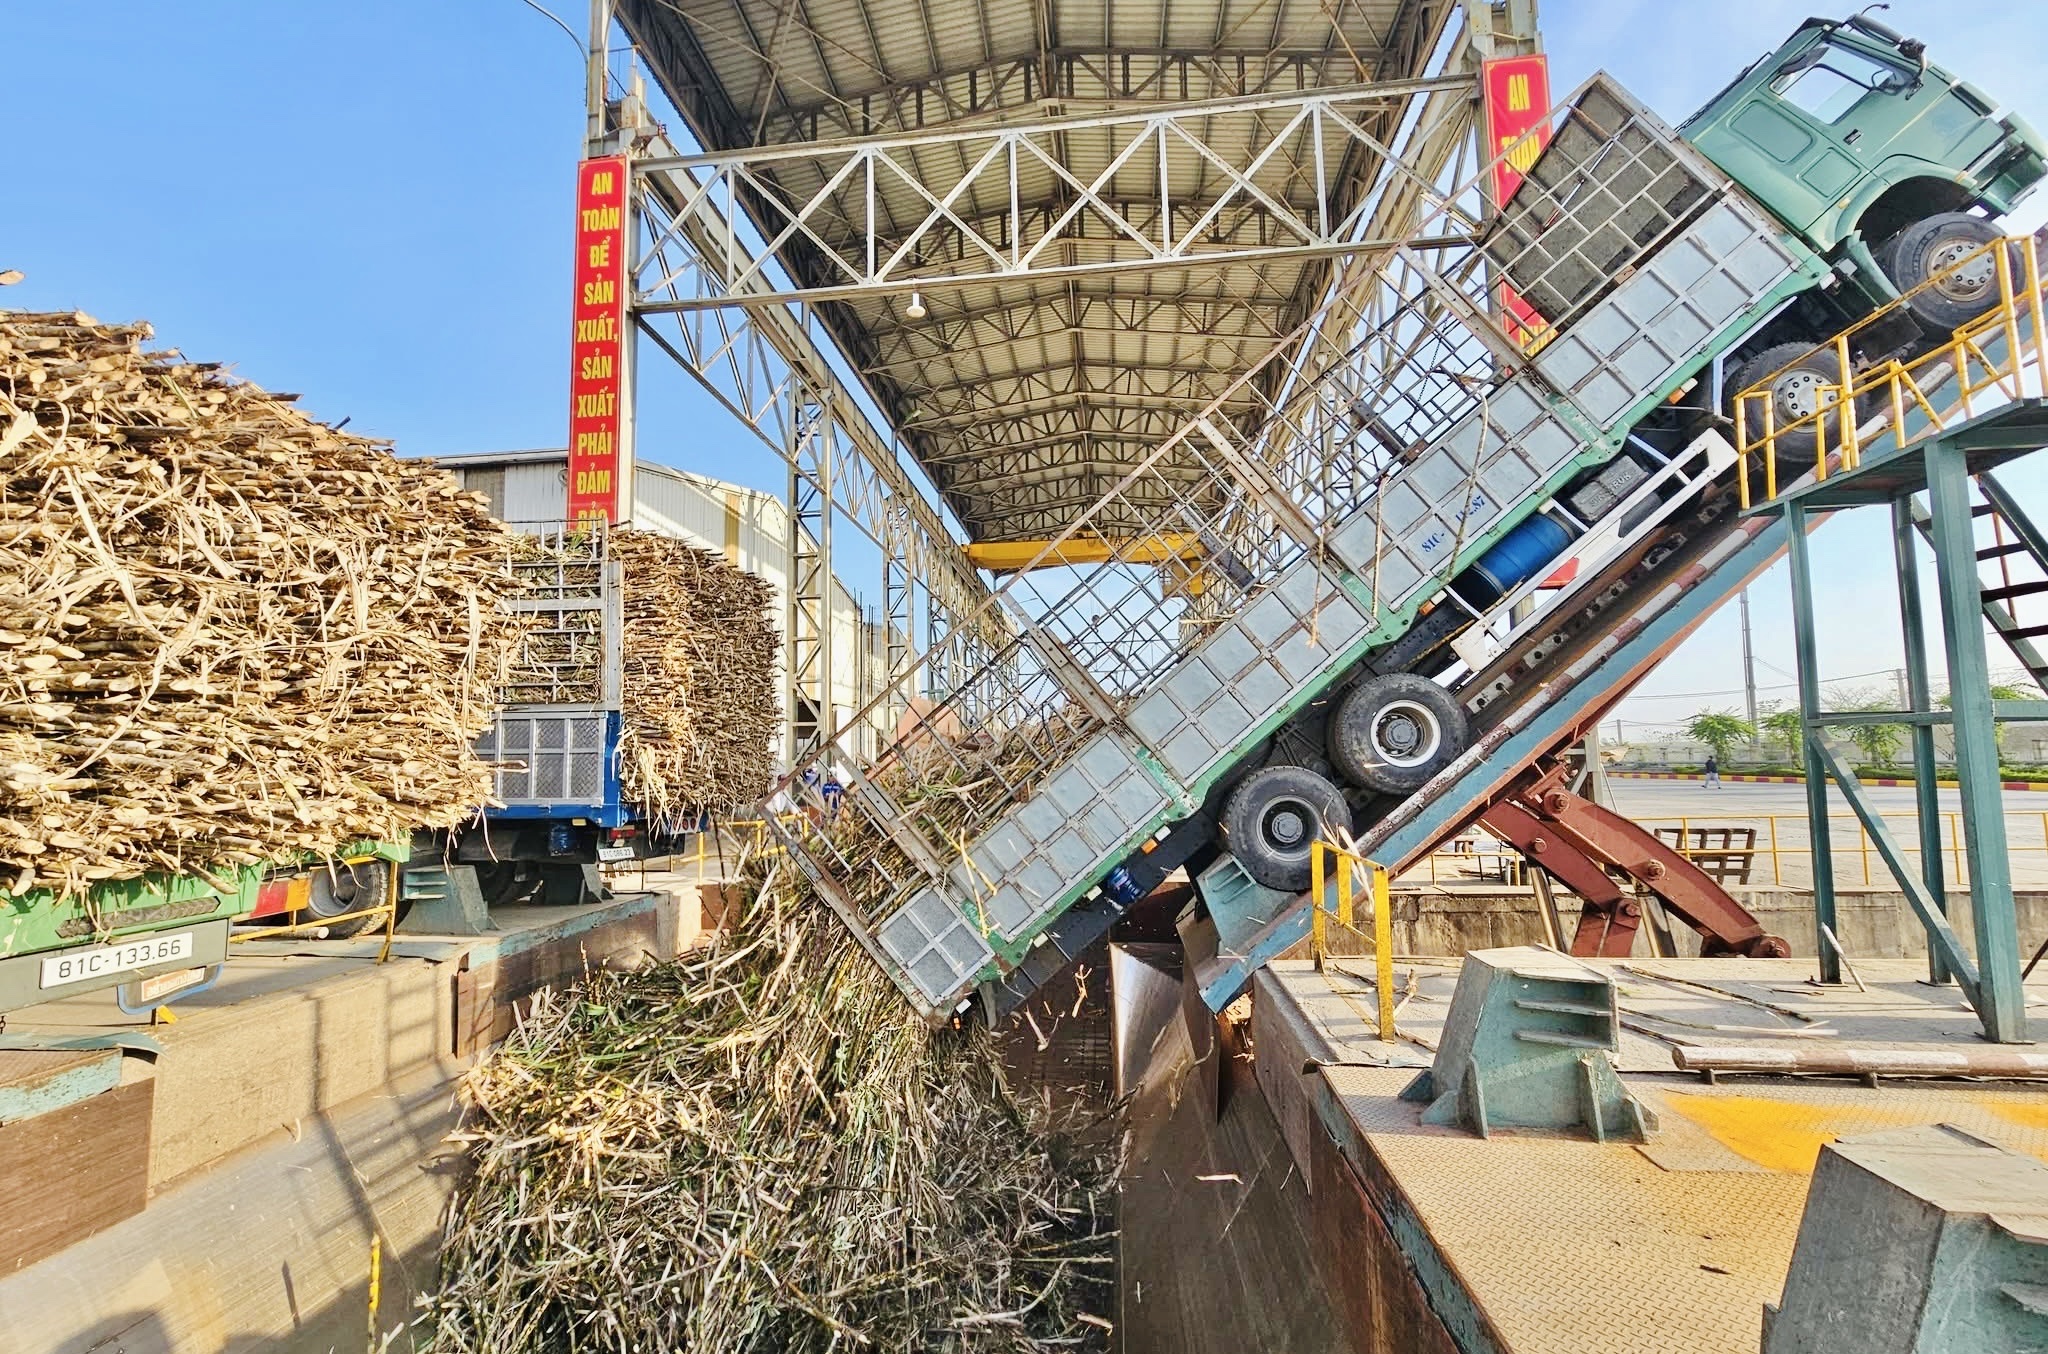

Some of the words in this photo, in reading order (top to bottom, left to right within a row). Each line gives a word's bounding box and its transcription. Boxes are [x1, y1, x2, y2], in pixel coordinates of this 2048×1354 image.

[1508, 74, 1531, 112] AN
[591, 172, 613, 195] AN
[582, 204, 620, 232] TOÀN
[589, 235, 611, 268] ĐỂ
[583, 273, 614, 305] SẢN
[577, 311, 618, 343] XUẤT,
[581, 347, 613, 380] SẢN
[576, 385, 616, 418] XUẤT
[577, 423, 613, 457] PHẢI
[576, 462, 611, 495] ĐẢM
[58, 938, 181, 979] 81C-133.66
